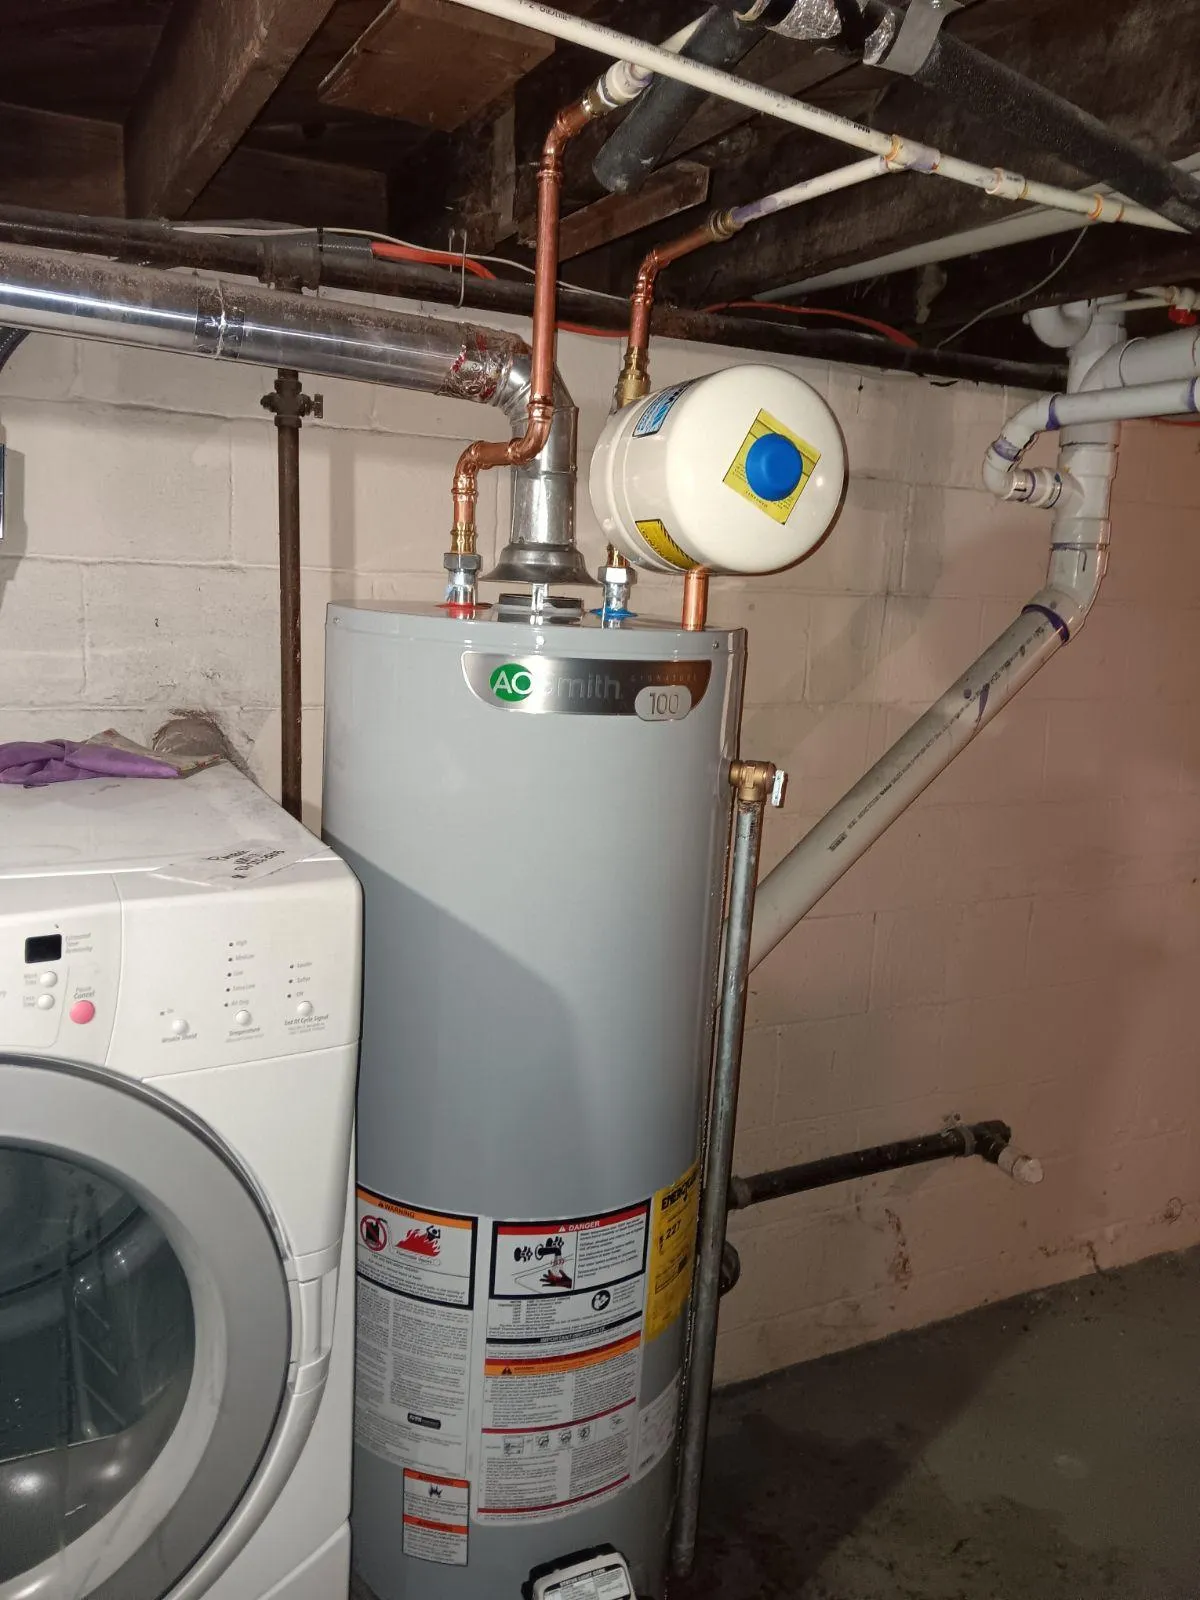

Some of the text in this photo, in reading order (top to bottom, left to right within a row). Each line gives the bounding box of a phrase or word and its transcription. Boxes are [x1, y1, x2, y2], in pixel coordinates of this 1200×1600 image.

[492, 669, 537, 697] AO
[649, 692, 679, 715] 100
[73, 990, 96, 1000] Cancel
[312, 1013, 329, 1023] Signal
[384, 1202, 416, 1219] WARNING
[568, 1221, 601, 1233] DANGER
